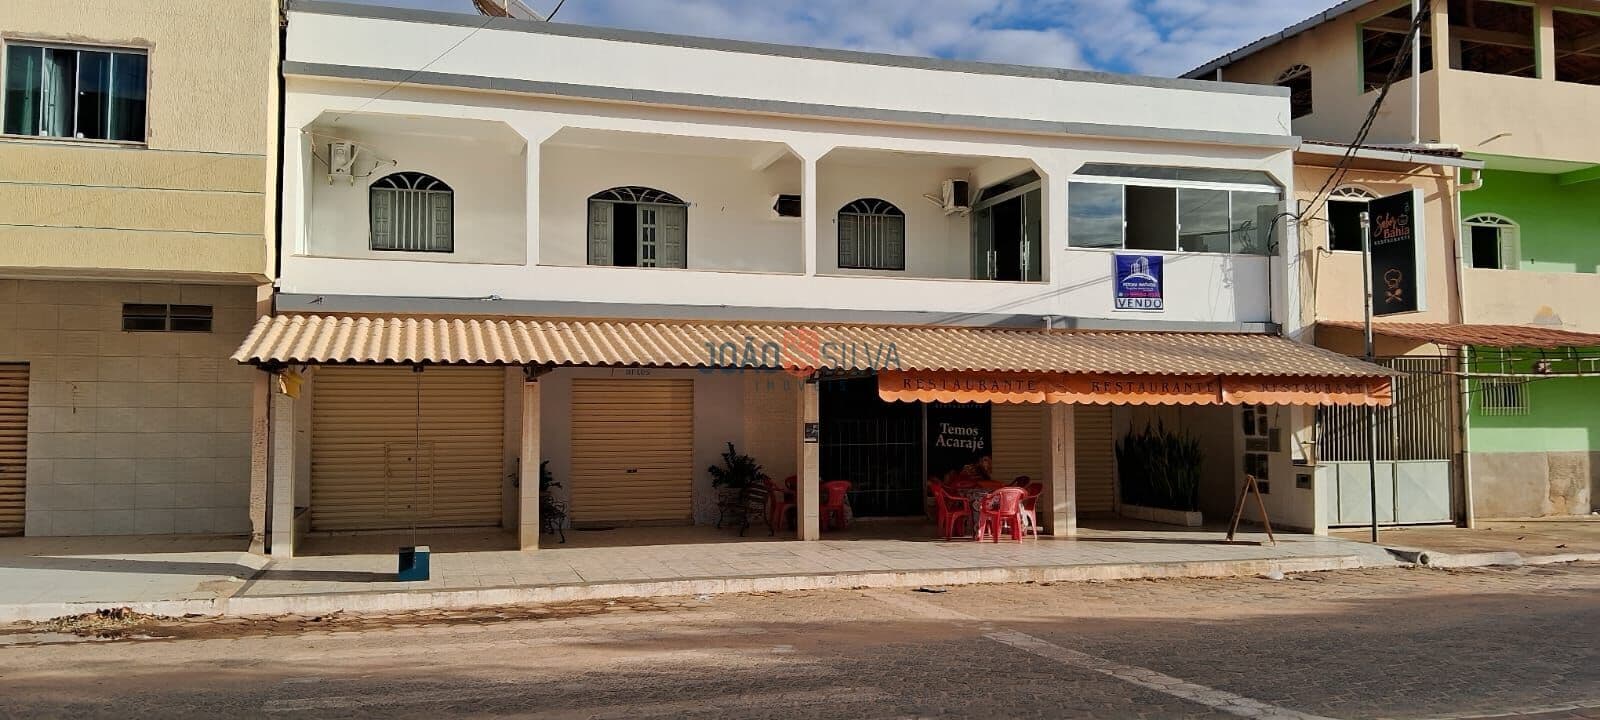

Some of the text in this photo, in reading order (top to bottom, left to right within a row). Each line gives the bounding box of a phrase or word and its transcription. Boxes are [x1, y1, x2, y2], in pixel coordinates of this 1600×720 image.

[1383, 225, 1410, 239] Bahia
[1118, 298, 1162, 308] VENDO
[903, 378, 1036, 390] RESTAURANTE
[1091, 381, 1215, 393] RESTAURANTE
[939, 422, 979, 436] Temos
[935, 434, 985, 453] Acarajé
